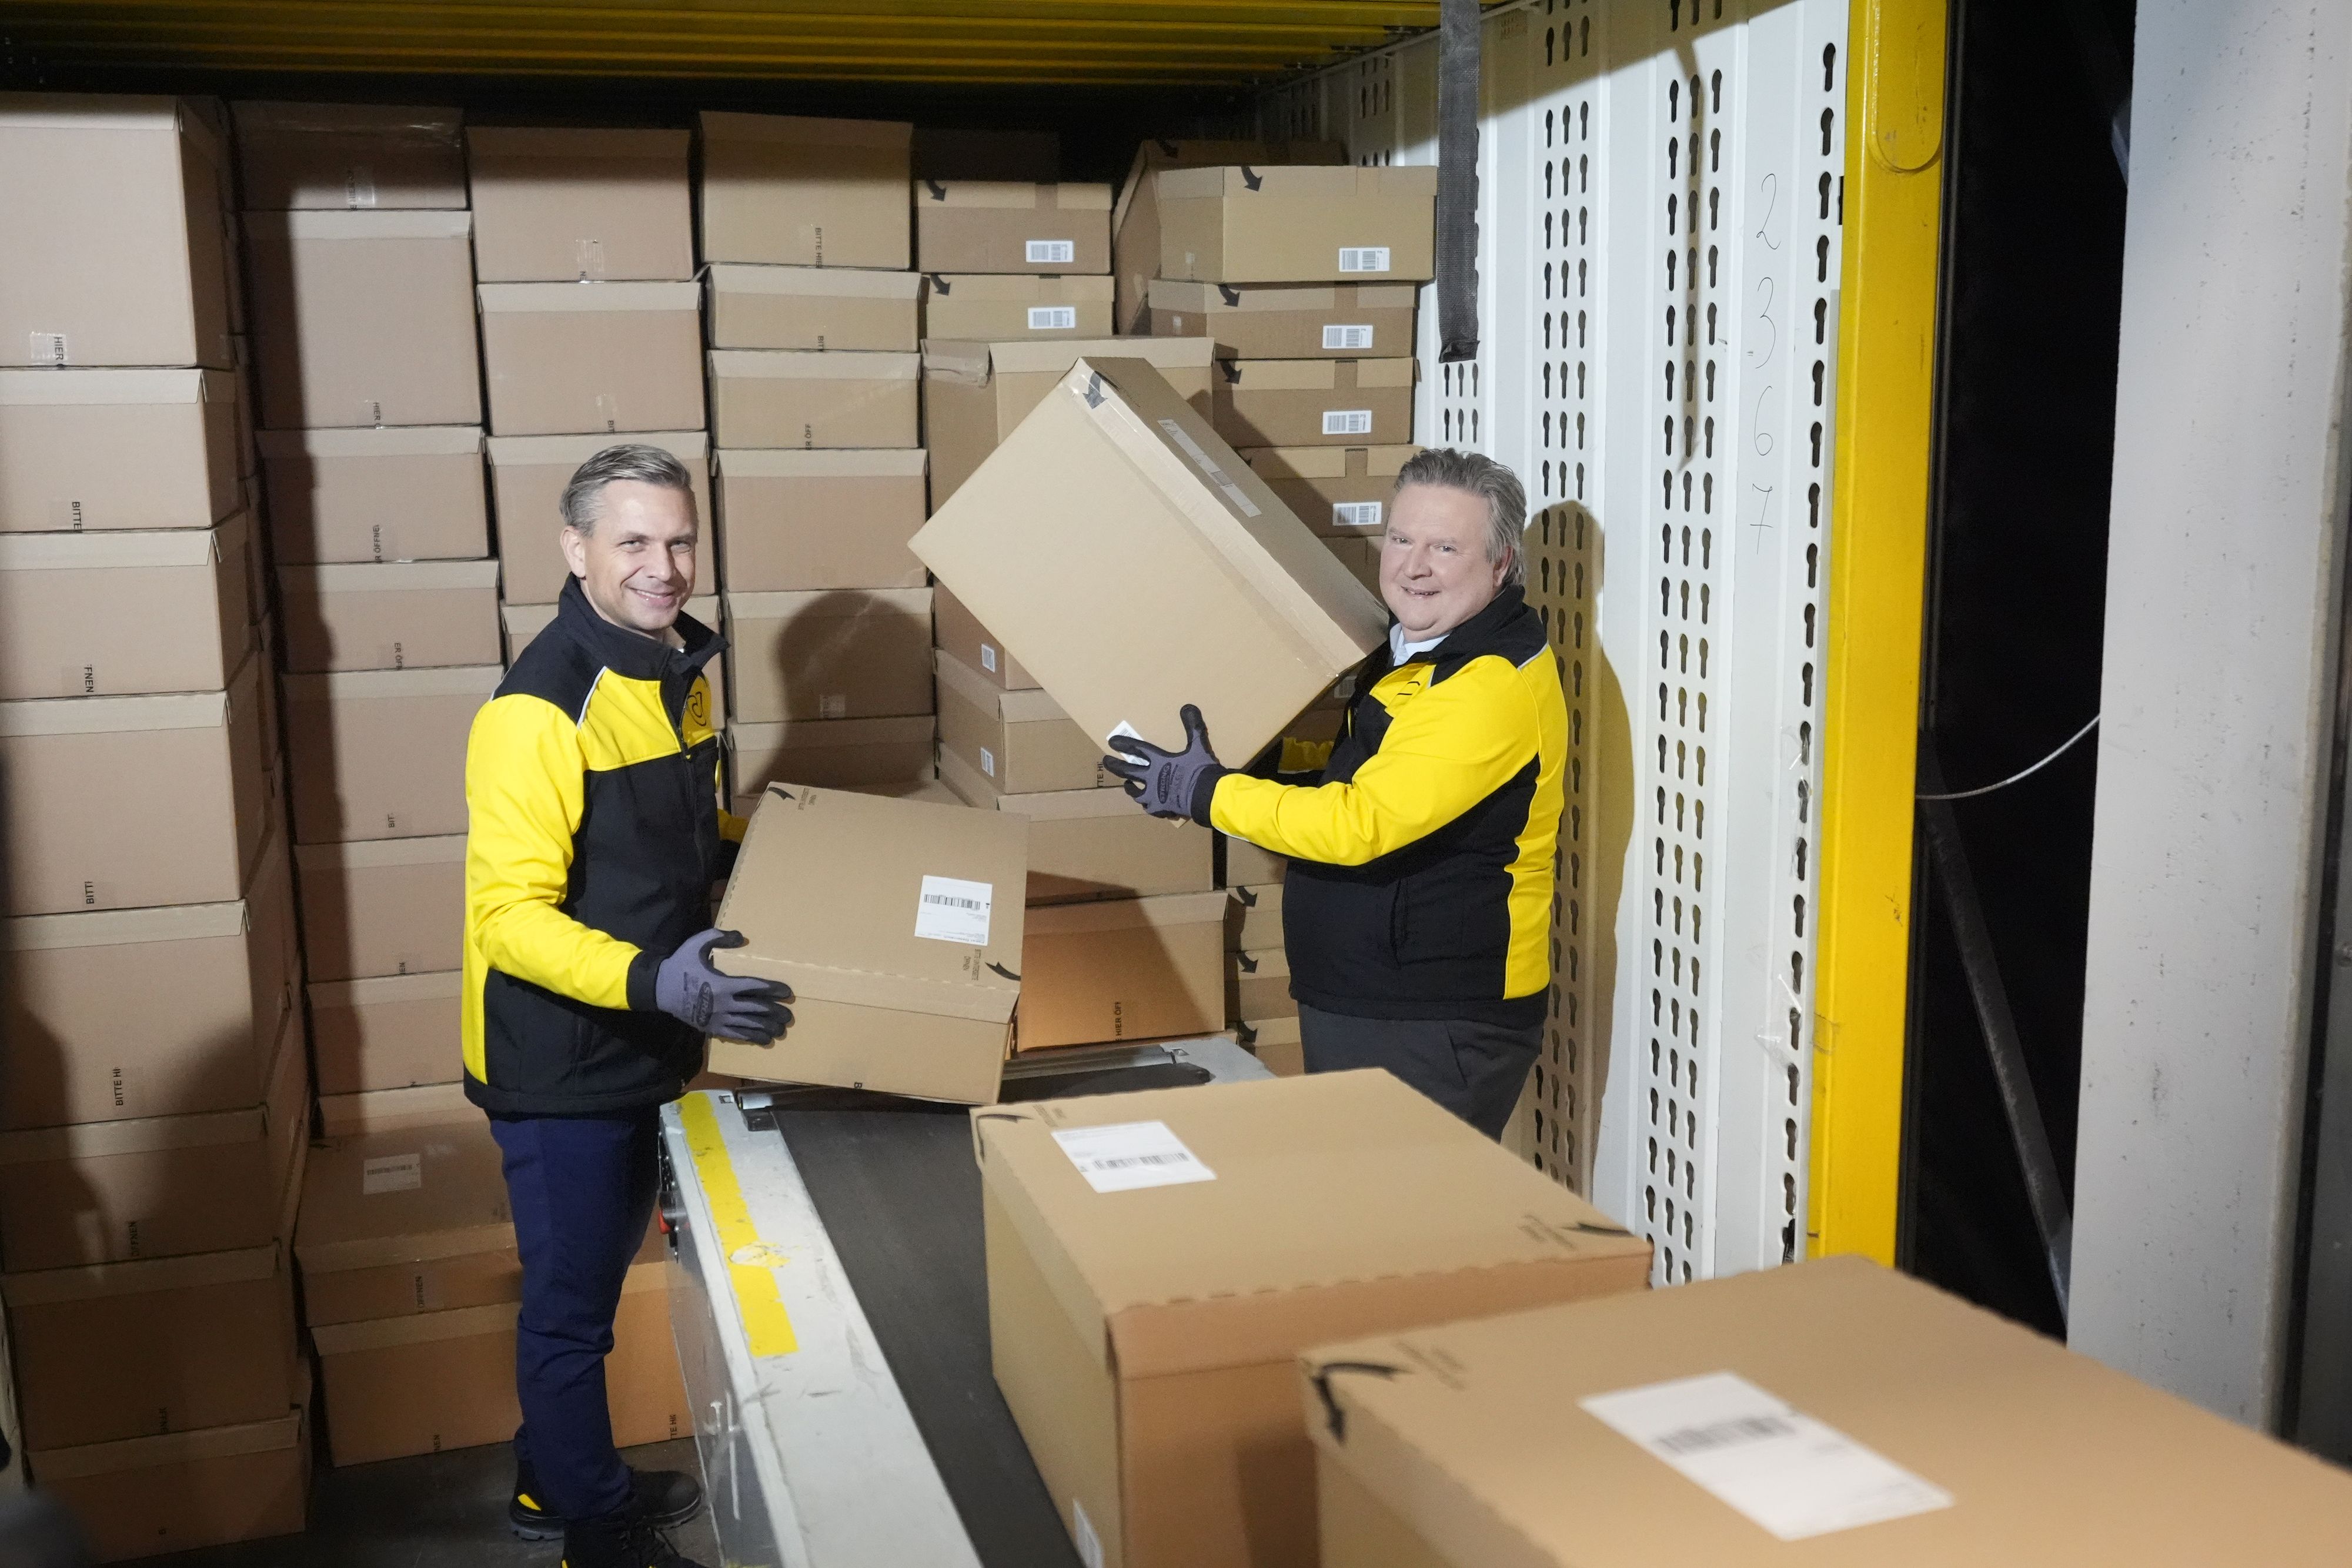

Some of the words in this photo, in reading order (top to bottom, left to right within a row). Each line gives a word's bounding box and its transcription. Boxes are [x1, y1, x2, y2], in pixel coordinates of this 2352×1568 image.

[54, 336, 64, 360] HIER
[373, 402, 381, 421] HIER
[72, 502, 82, 530] BITTE
[84, 664, 94, 693] FNEN
[387, 813, 395, 828] BIT
[114, 1080, 123, 1106] BITTE
